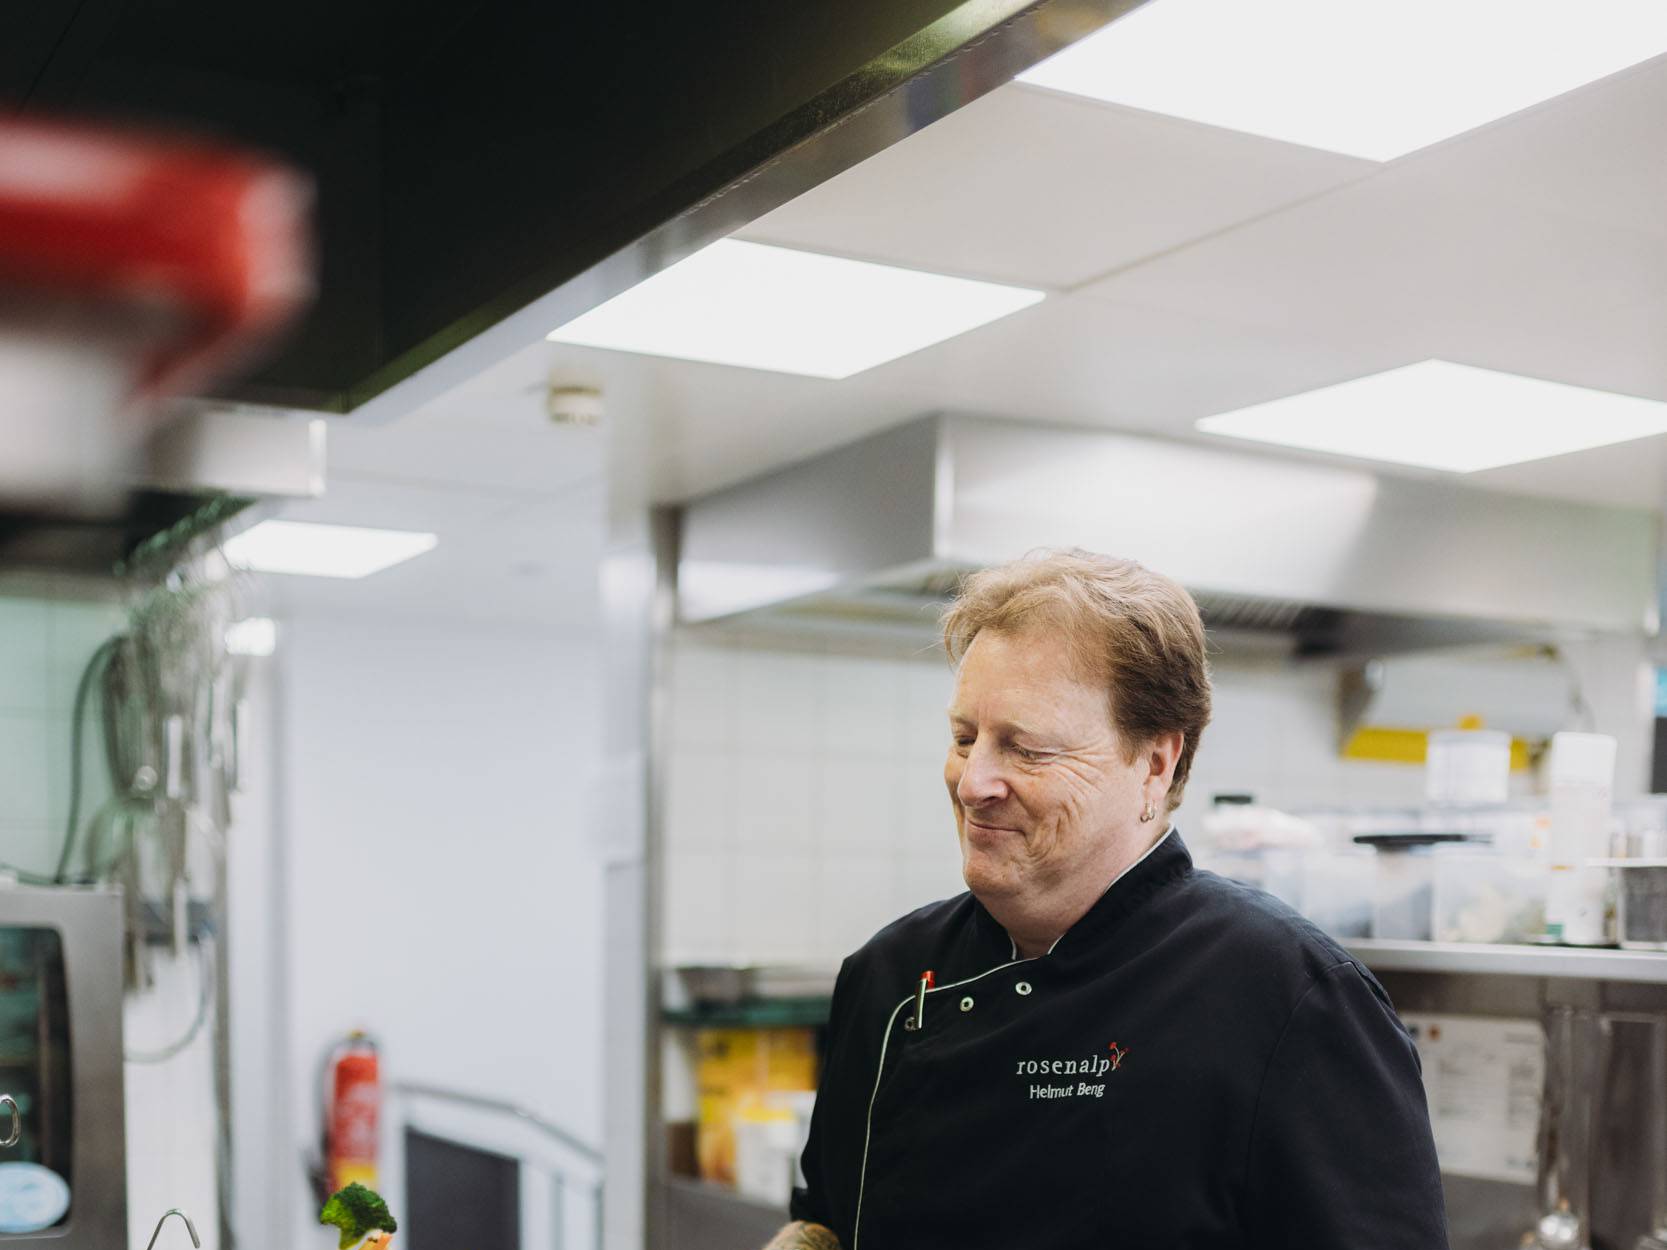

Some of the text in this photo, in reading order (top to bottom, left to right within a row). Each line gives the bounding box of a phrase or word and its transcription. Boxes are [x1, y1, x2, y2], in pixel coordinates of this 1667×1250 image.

[1016, 1054, 1110, 1077] rosenalp
[1030, 1082, 1106, 1099] Helmut Beng
